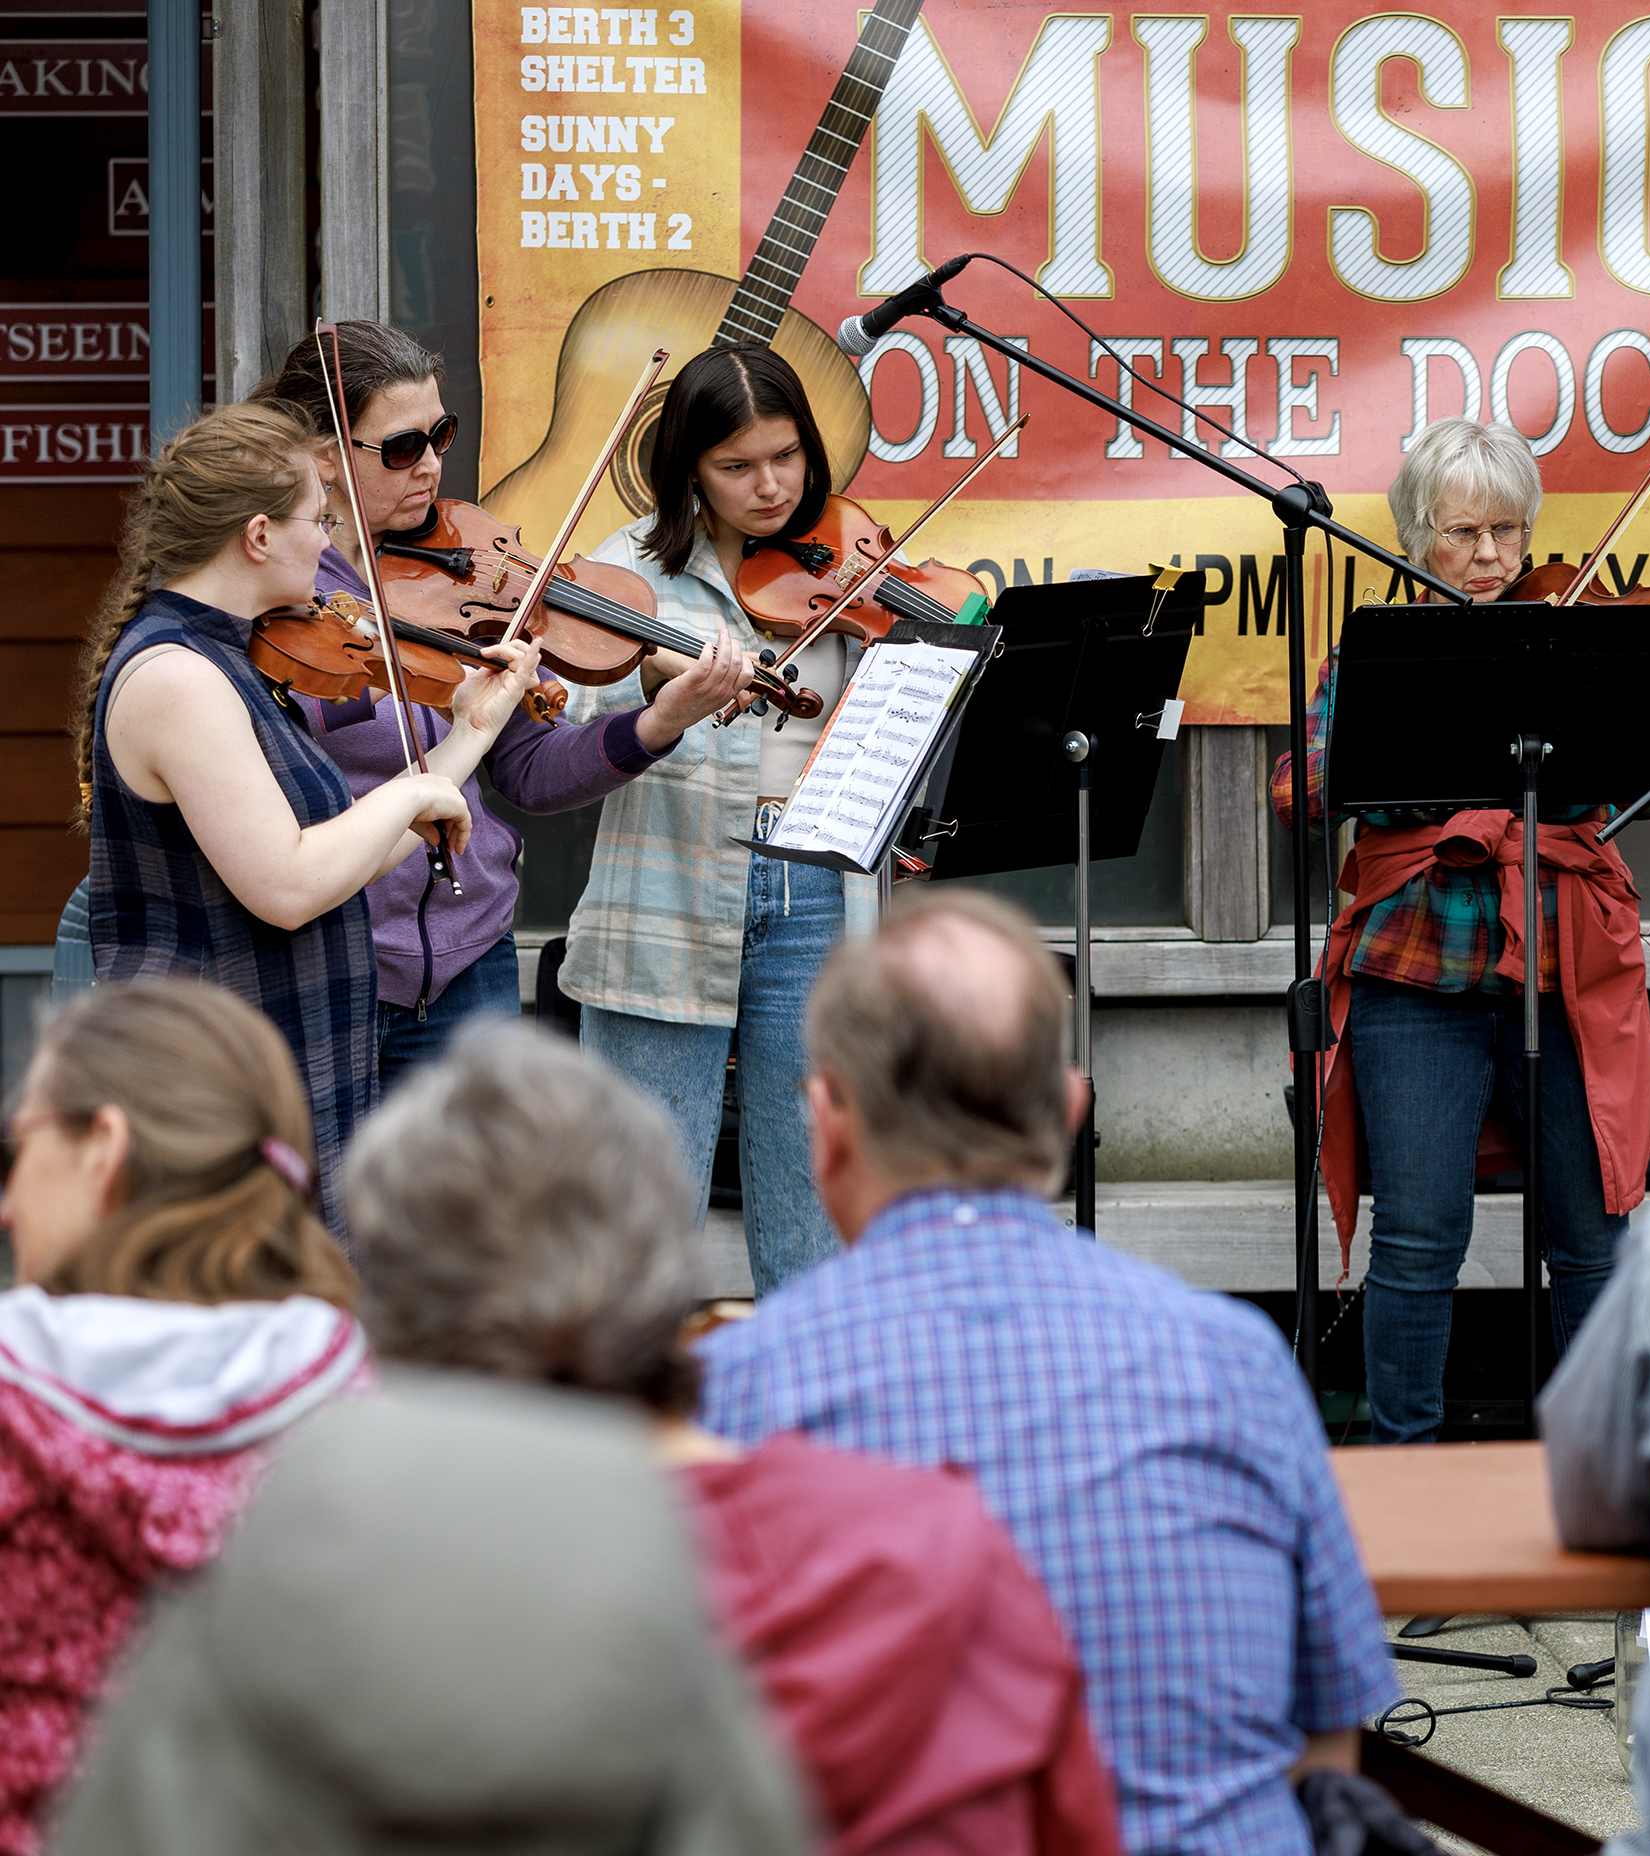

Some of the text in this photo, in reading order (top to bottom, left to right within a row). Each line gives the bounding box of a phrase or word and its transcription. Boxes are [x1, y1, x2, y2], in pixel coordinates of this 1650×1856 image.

[521, 7, 695, 46] BERTH 3
[520, 55, 707, 94] SHELTER
[521, 115, 676, 154] SUNNY
[521, 163, 642, 202] DAYS
[520, 211, 692, 250] BERTH 2
[858, 330, 1030, 464] ON
[1088, 335, 1342, 460] THE
[1, 422, 150, 464] FISHI
